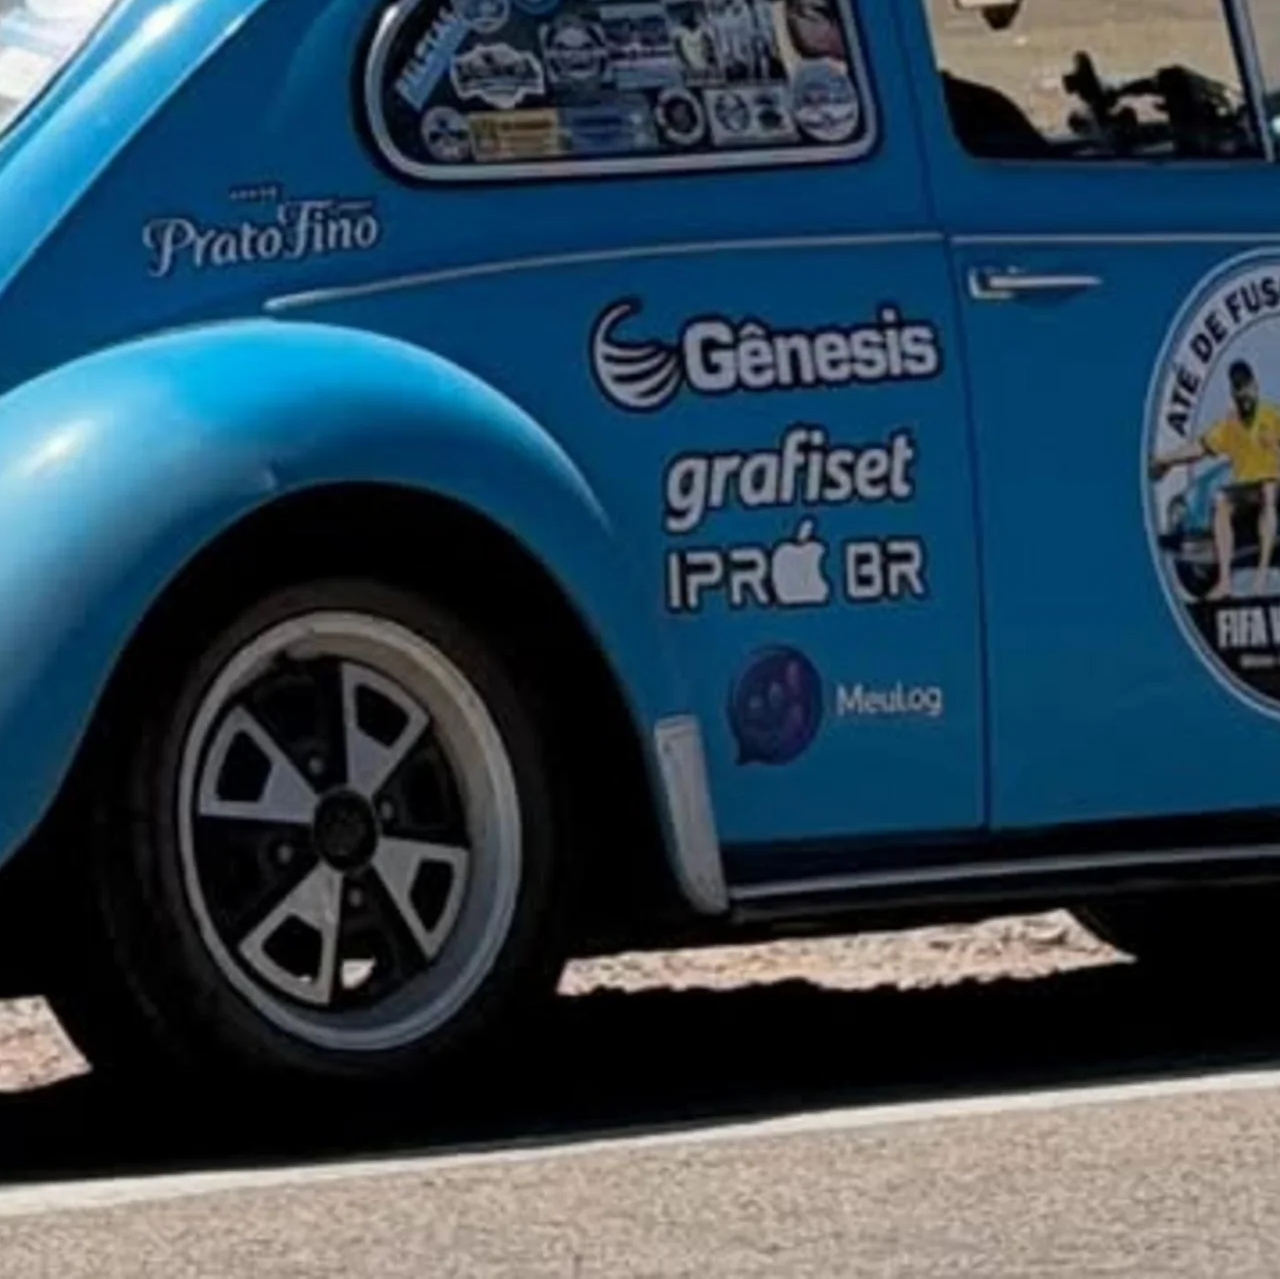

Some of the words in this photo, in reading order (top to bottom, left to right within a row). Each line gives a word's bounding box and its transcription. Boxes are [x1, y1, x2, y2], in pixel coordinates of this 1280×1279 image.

[142, 217, 282, 277] Prato
[683, 308, 939, 391] Gênesis
[1189, 312, 1229, 365] DE
[667, 430, 914, 530] grafiset
[844, 540, 925, 599] BR
[1216, 607, 1268, 647] FIFA
